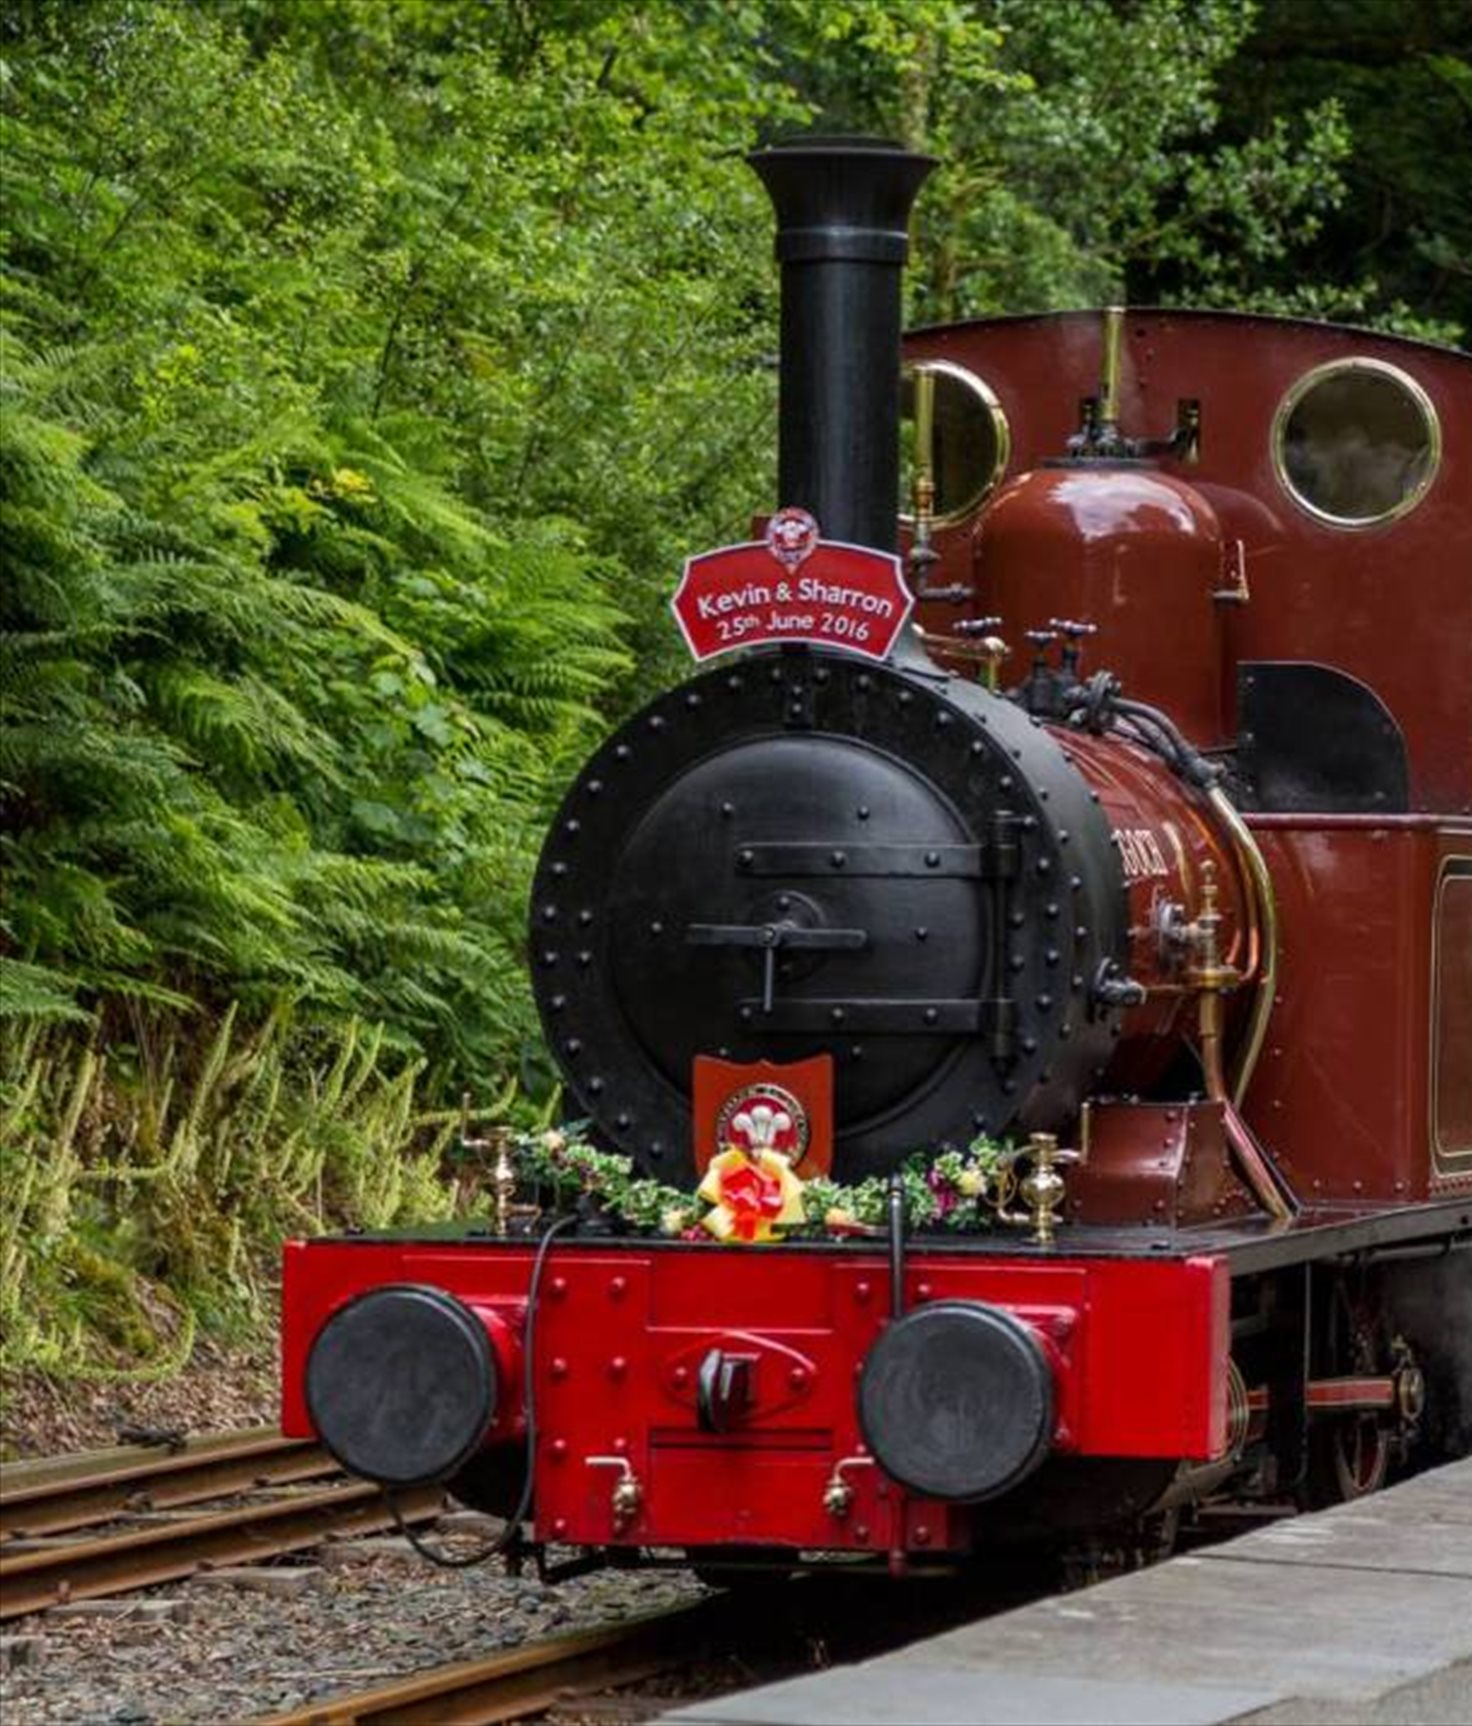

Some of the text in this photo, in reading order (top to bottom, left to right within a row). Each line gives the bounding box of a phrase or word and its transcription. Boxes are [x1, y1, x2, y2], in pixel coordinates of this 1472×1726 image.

[698, 579, 892, 619] Kevin & Sharron
[717, 611, 870, 641] 25th June 2016
